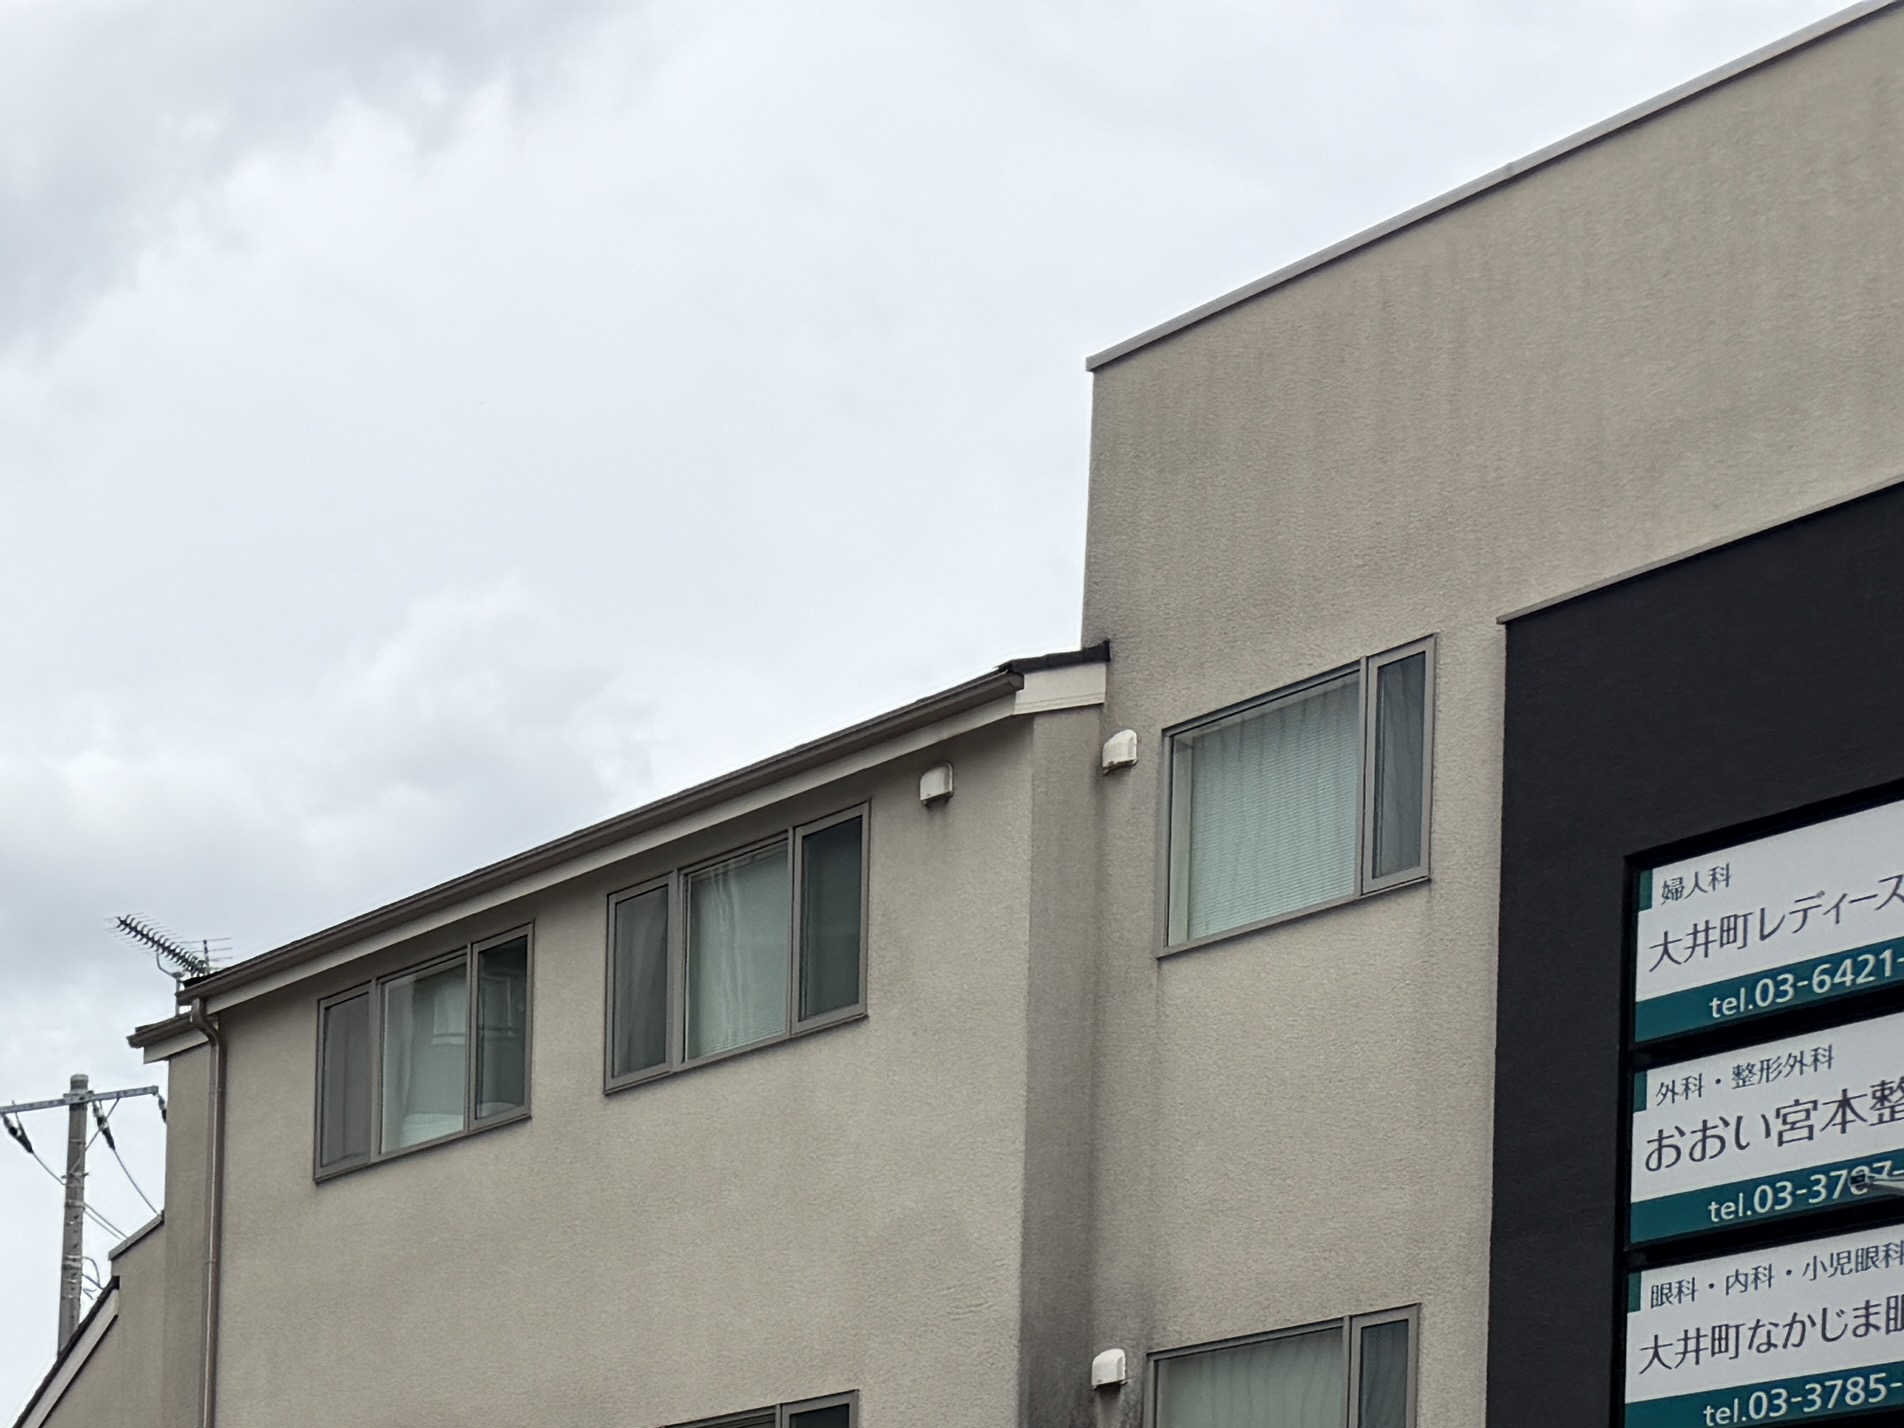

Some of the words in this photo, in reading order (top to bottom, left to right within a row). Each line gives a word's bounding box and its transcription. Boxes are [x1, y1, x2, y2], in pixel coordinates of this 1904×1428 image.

[1660, 863, 1732, 906] 婦人科
[1648, 873, 1904, 973] 大井町レディース
[1654, 1043, 1835, 1107] 外科・整形外科
